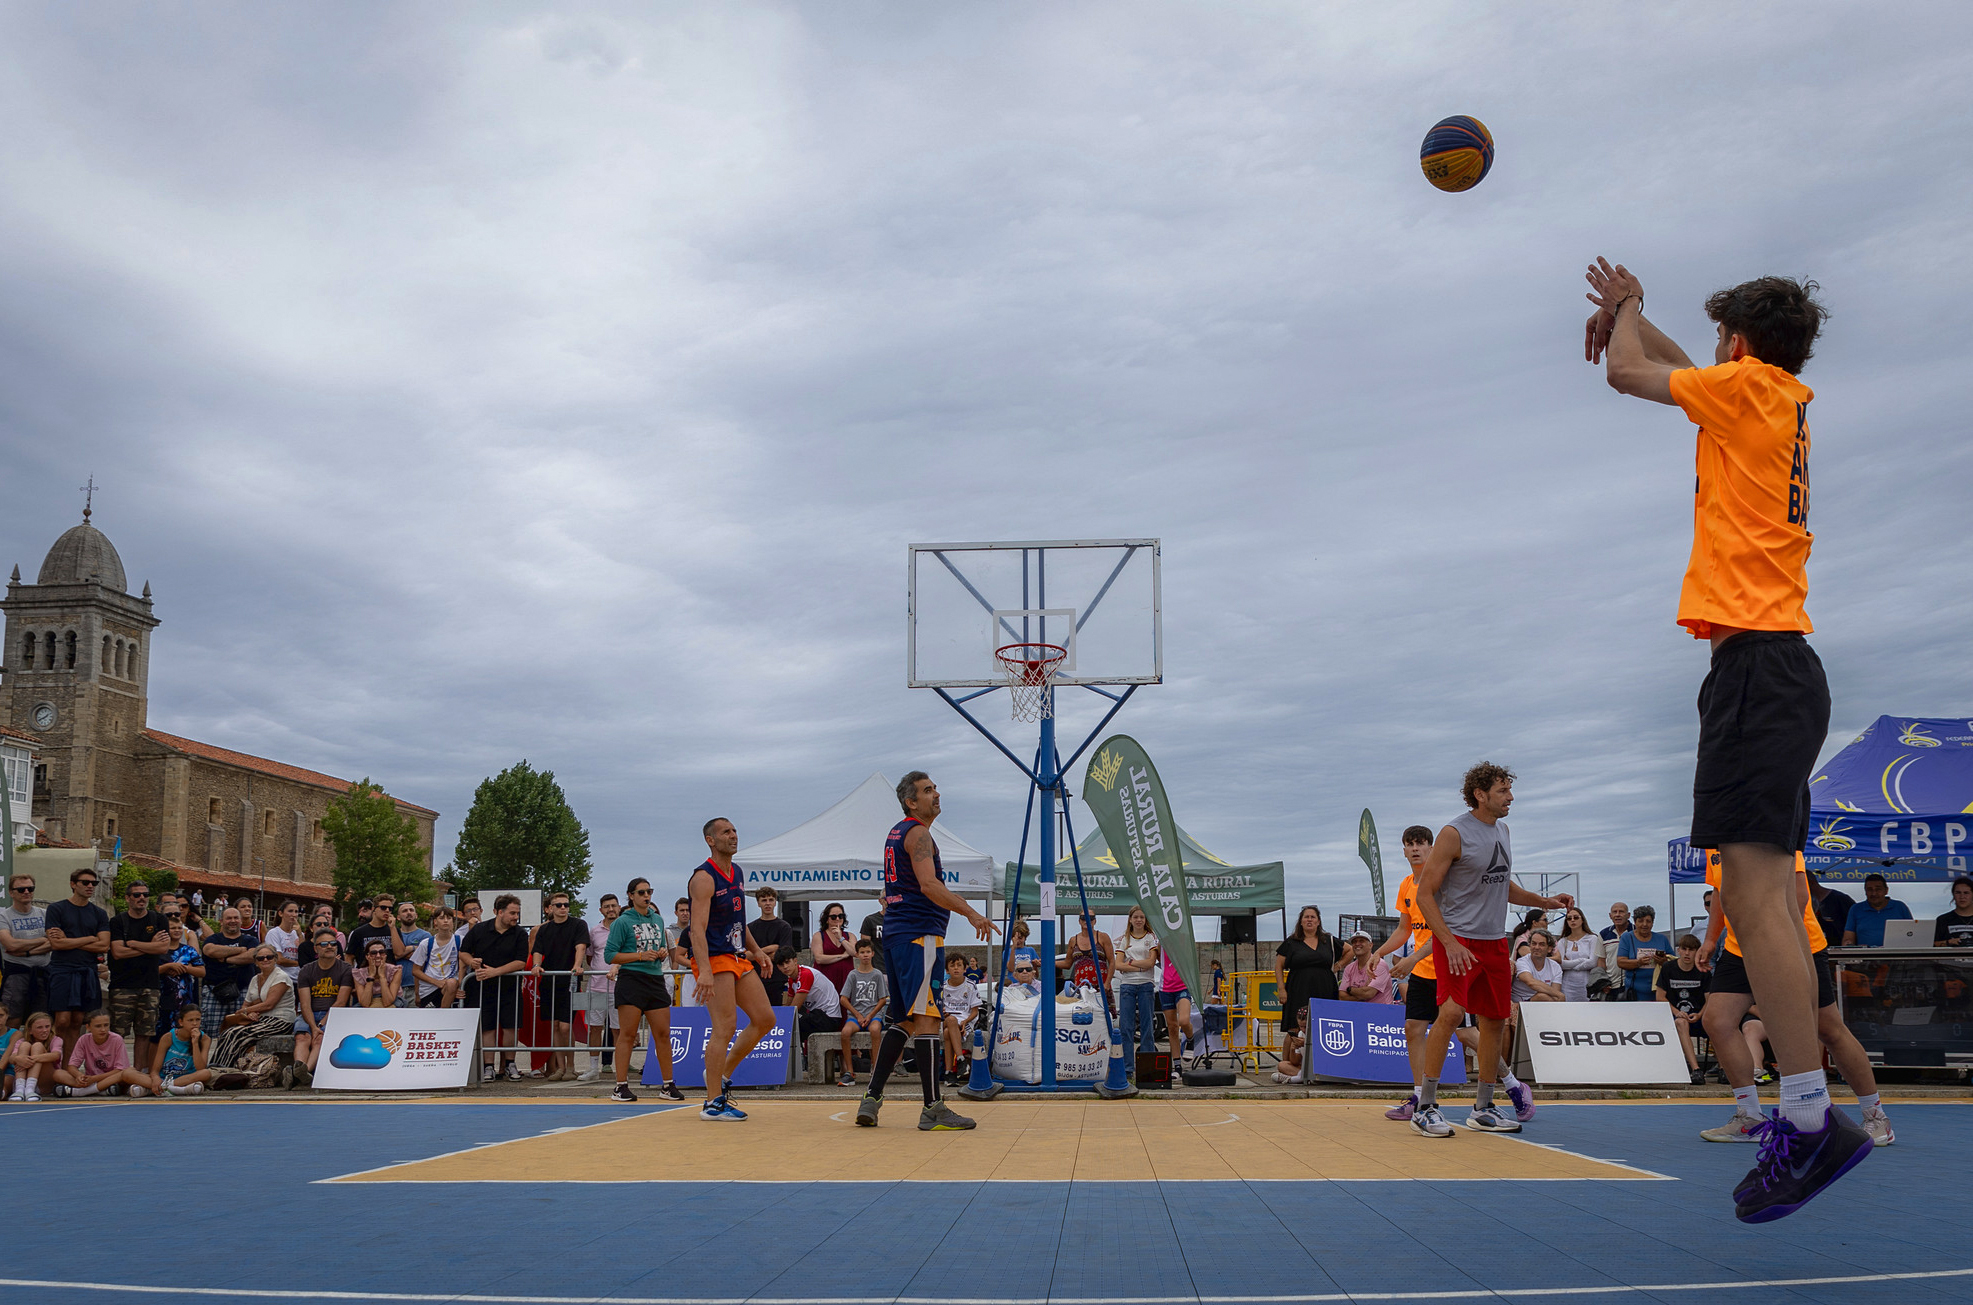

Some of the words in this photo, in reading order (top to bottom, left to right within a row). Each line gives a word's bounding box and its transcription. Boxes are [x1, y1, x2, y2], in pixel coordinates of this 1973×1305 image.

[748, 868, 872, 882] AYUNTAMIENTO
[1034, 873, 1072, 887] CJA
[1076, 874, 1129, 888] RURAL
[1202, 875, 1255, 889] RURAL
[1191, 892, 1241, 901] ASTURIAS
[770, 1026, 785, 1036] de
[409, 1032, 436, 1041] THE
[1539, 1031, 1665, 1046] SIROKO
[406, 1041, 461, 1051] BASKET
[404, 1051, 459, 1060] DREAM
[1063, 1063, 1076, 1072] 985
[1078, 1064, 1086, 1072] 34
[1088, 1062, 1095, 1071] 33
[1154, 1055, 1169, 1082] 9
[1078, 1070, 1100, 1078] ASTURIAS
